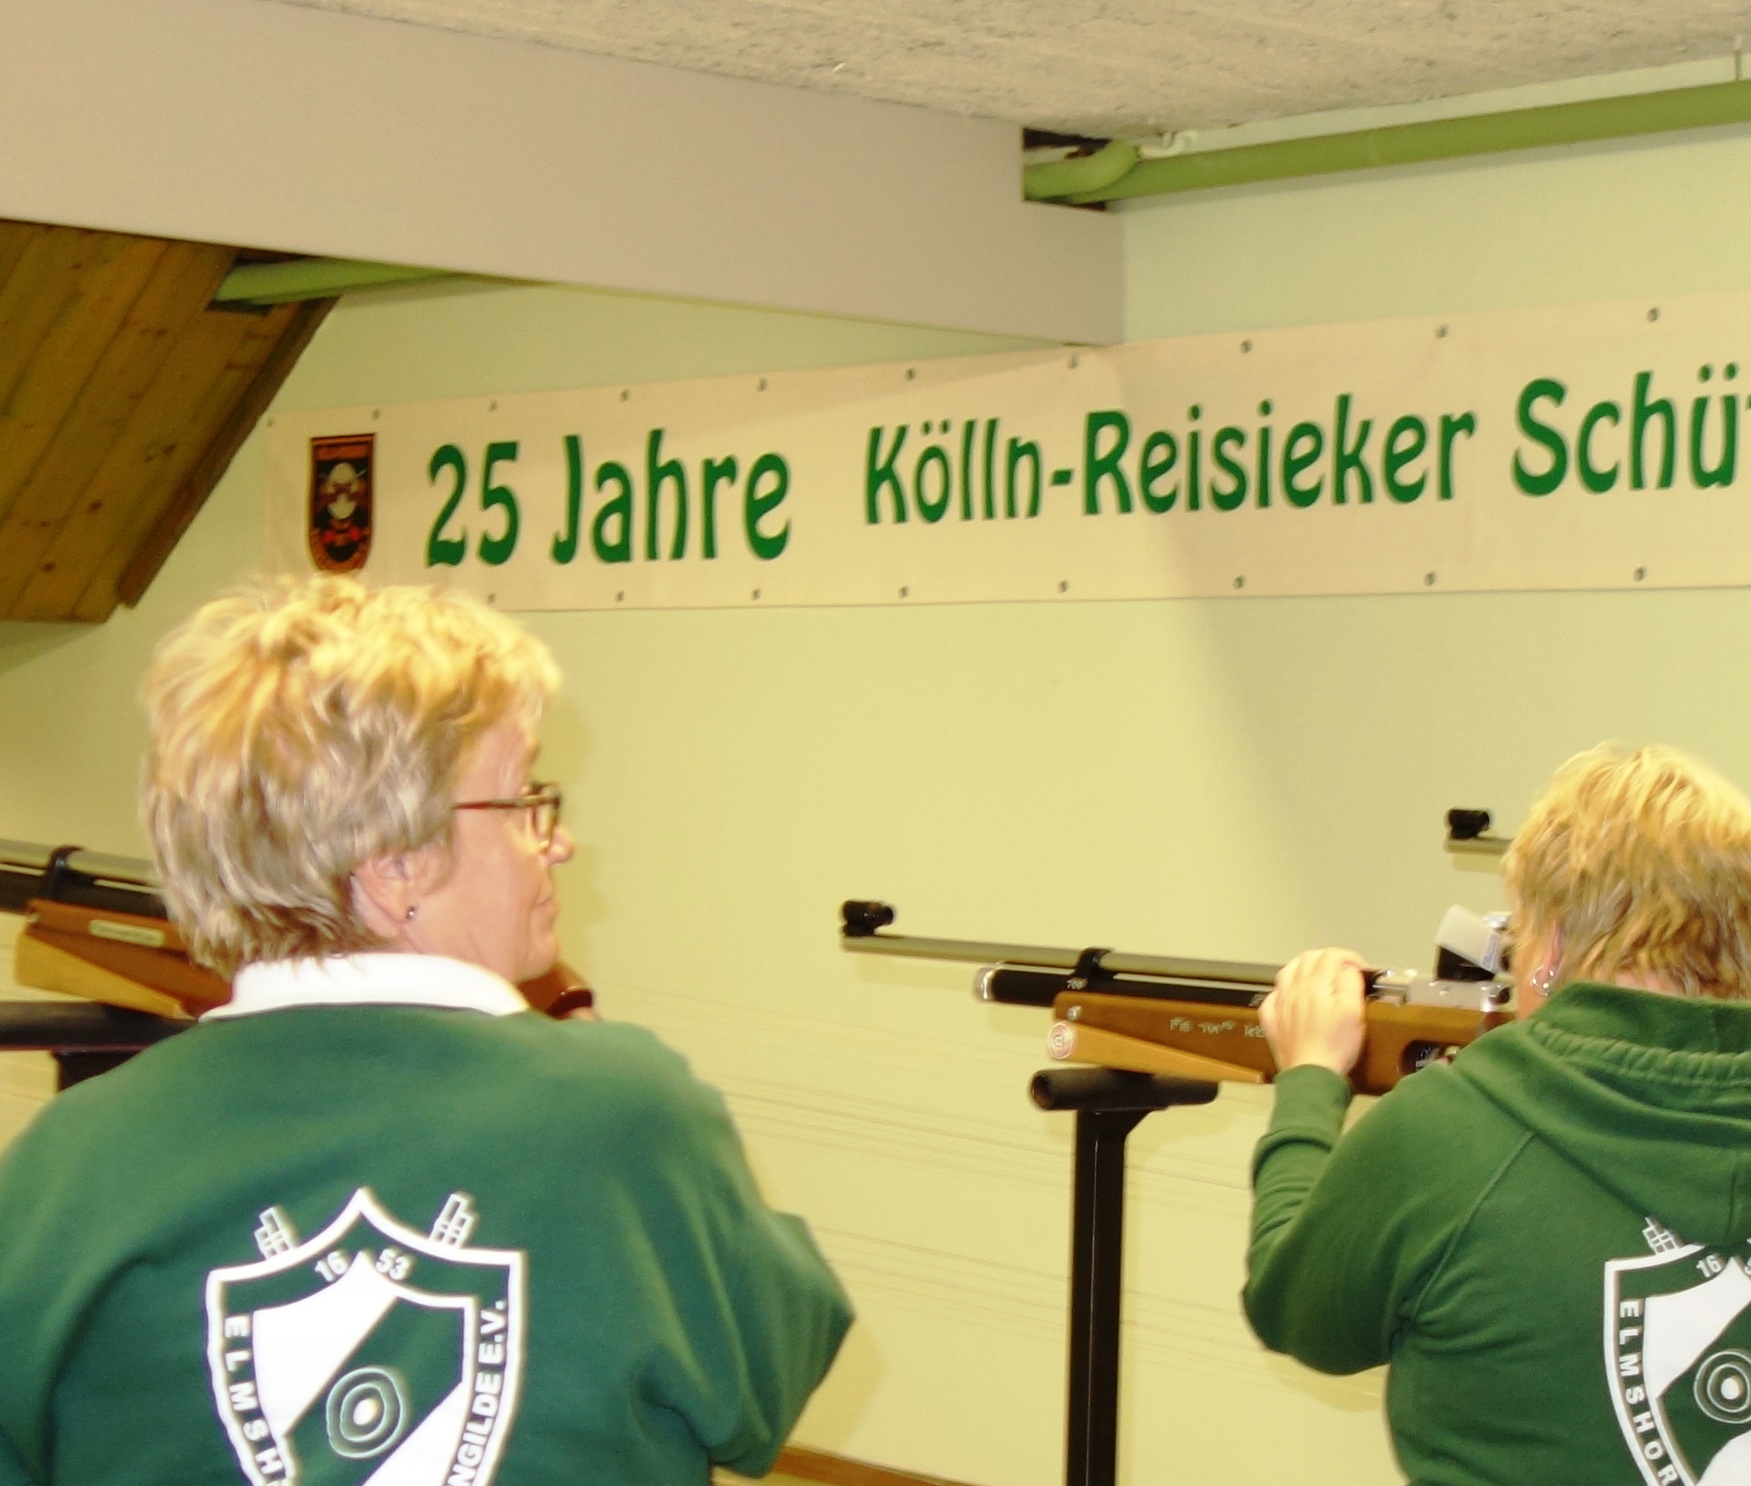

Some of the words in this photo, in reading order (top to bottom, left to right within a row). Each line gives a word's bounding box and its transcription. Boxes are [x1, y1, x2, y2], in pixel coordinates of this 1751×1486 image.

[426, 440, 521, 569] 25
[551, 428, 792, 565] Jahre
[864, 391, 1476, 526] Kölln-Reisieker
[315, 1250, 348, 1282] 16
[376, 1248, 411, 1281] 53
[1696, 1253, 1723, 1280] 16
